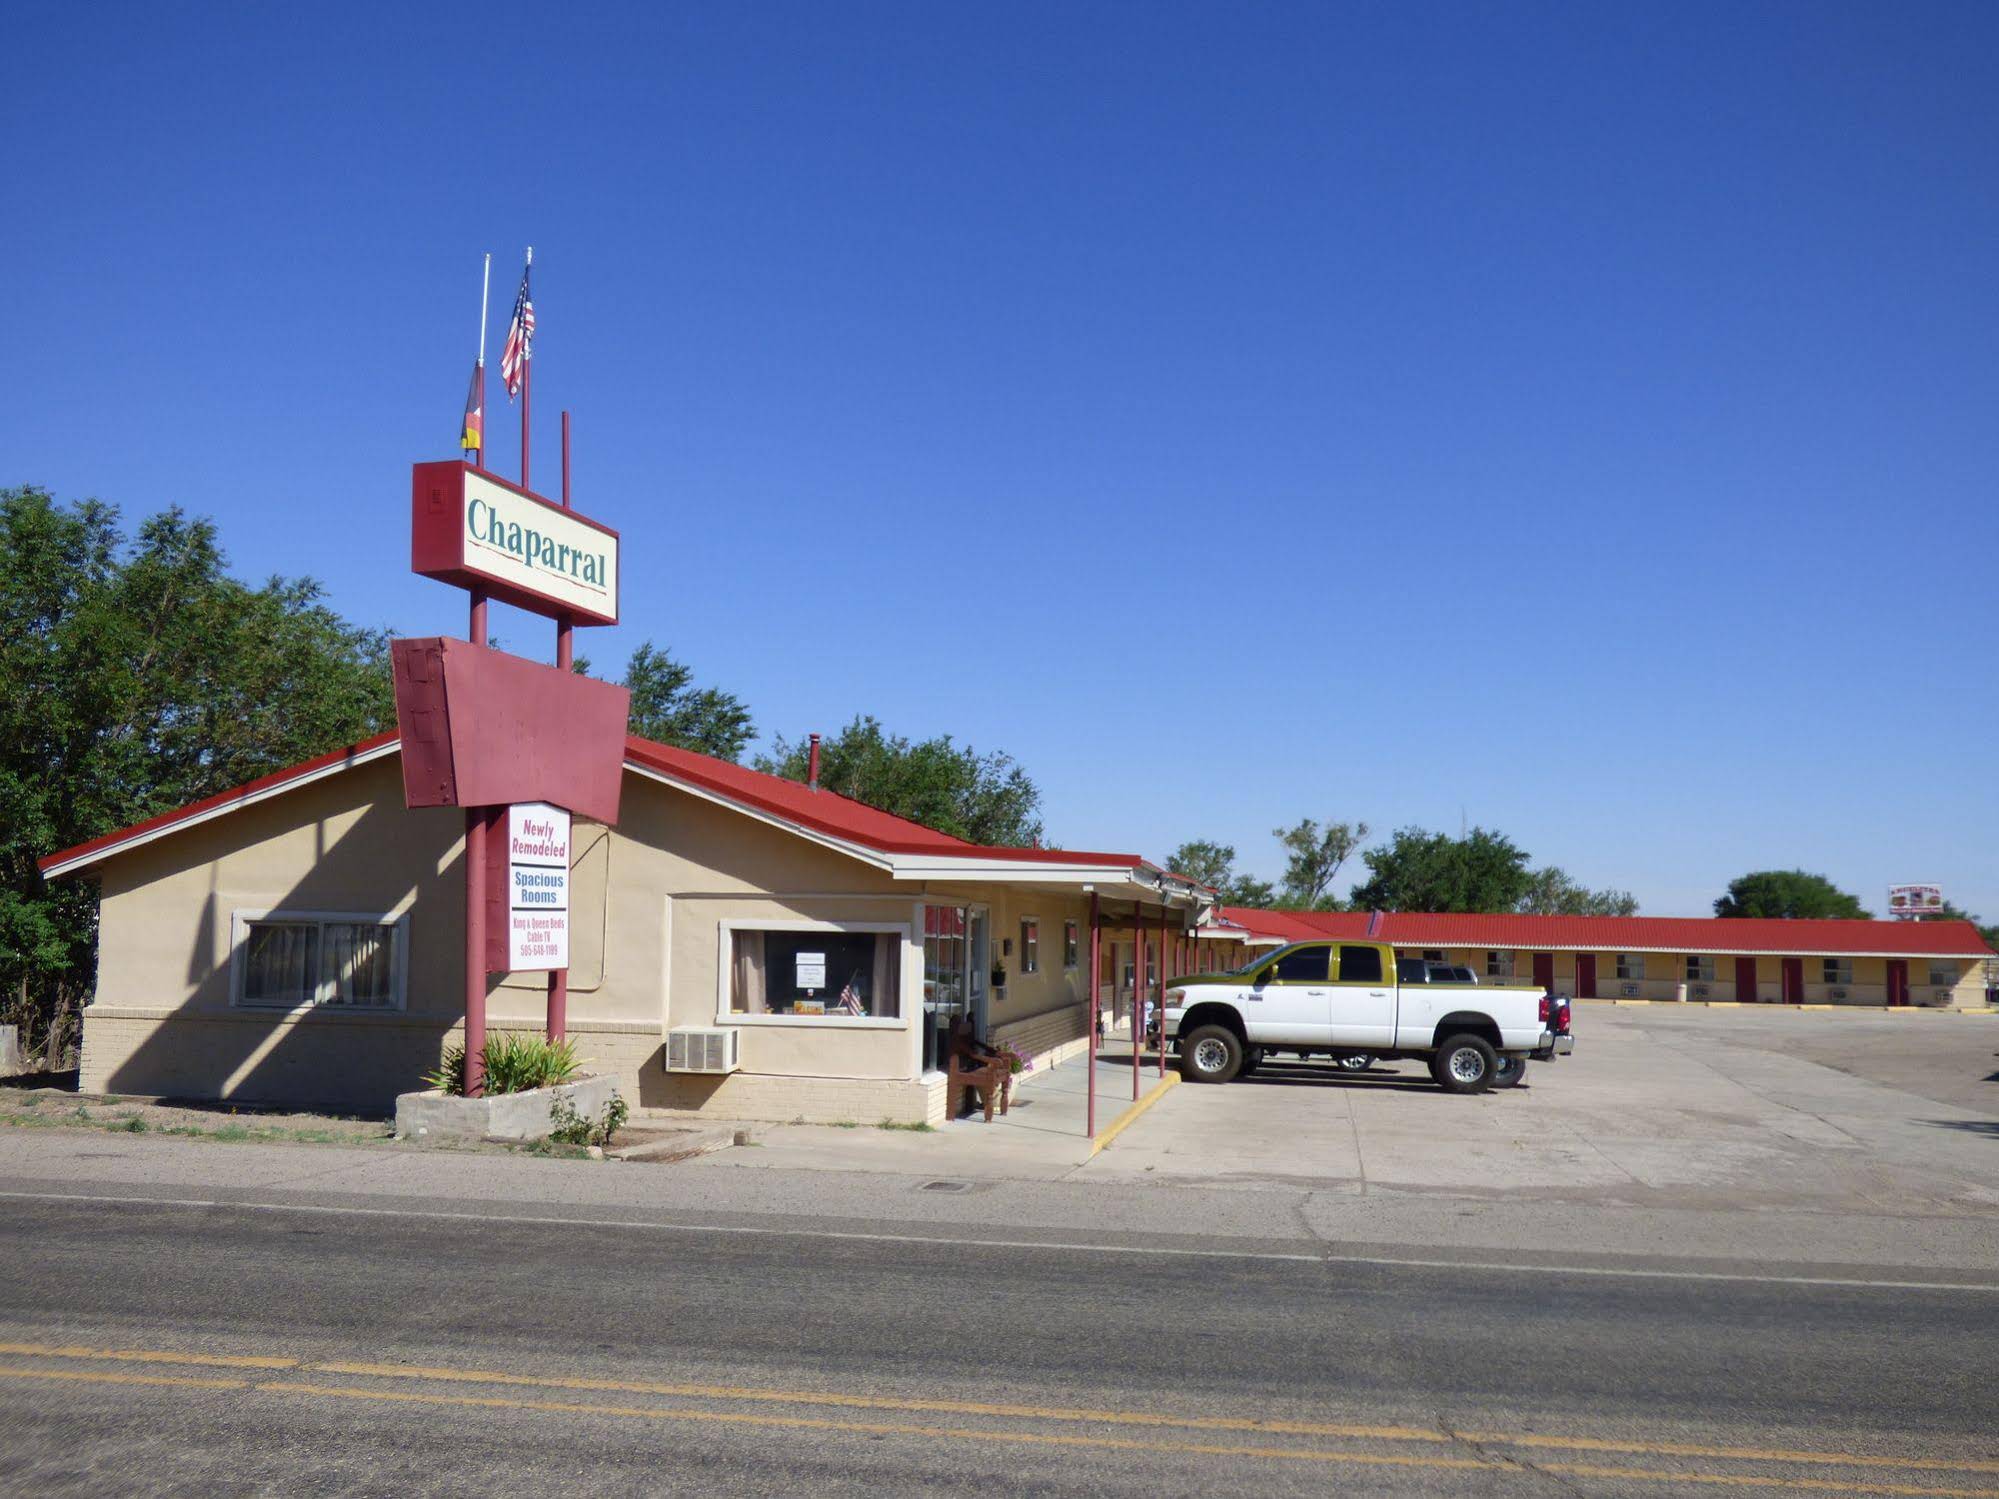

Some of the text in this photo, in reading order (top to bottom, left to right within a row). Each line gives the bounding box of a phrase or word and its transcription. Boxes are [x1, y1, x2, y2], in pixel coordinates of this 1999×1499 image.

[468, 498, 607, 588] Chaparral
[523, 819, 554, 842] Newly
[511, 837, 566, 858] Remodeled
[515, 871, 564, 887] Spacious
[521, 888, 557, 904] Rooms
[513, 917, 526, 930] King
[532, 917, 549, 929] Queen
[550, 917, 565, 929] Beds
[527, 930, 551, 943] Cable TV
